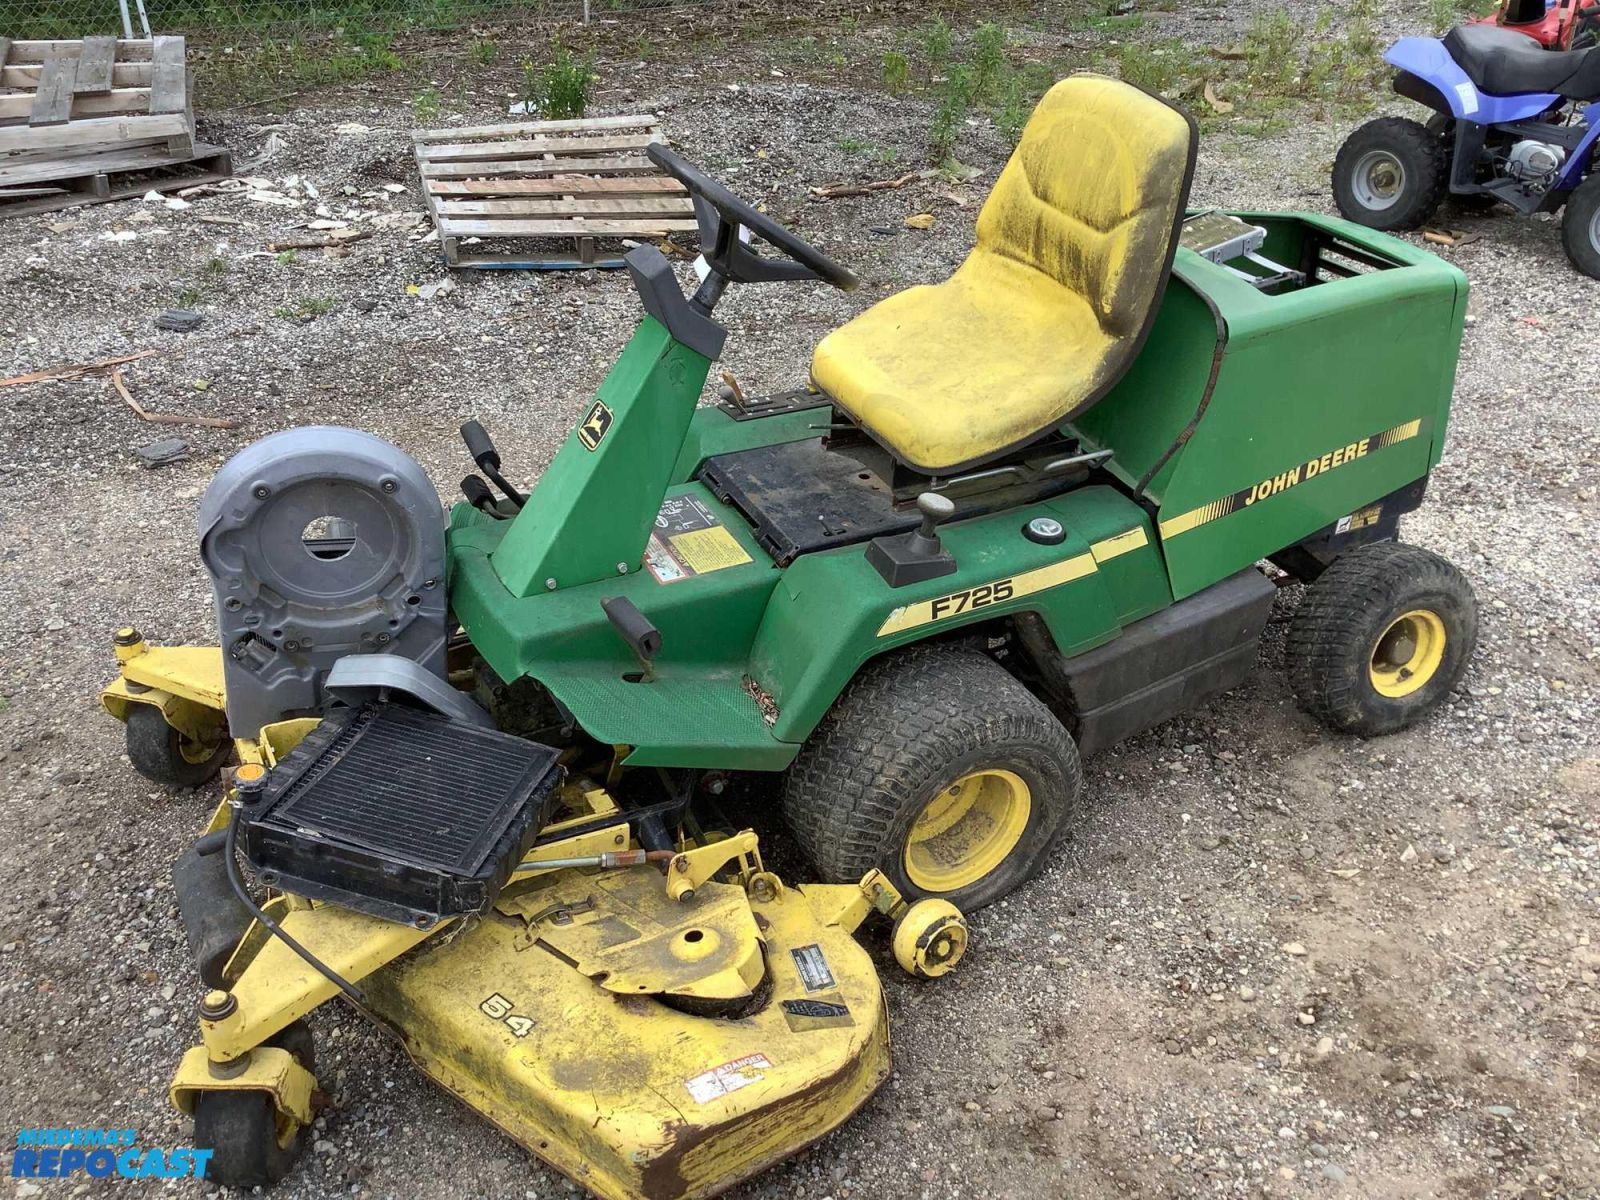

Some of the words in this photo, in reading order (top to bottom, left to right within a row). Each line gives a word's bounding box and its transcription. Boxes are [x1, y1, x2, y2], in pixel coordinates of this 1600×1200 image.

[1245, 467, 1301, 506] JOHN
[1306, 438, 1370, 480] DEERE
[931, 579, 1014, 620] F725
[479, 992, 537, 1039] 54
[725, 1054, 766, 1073] DANGER
